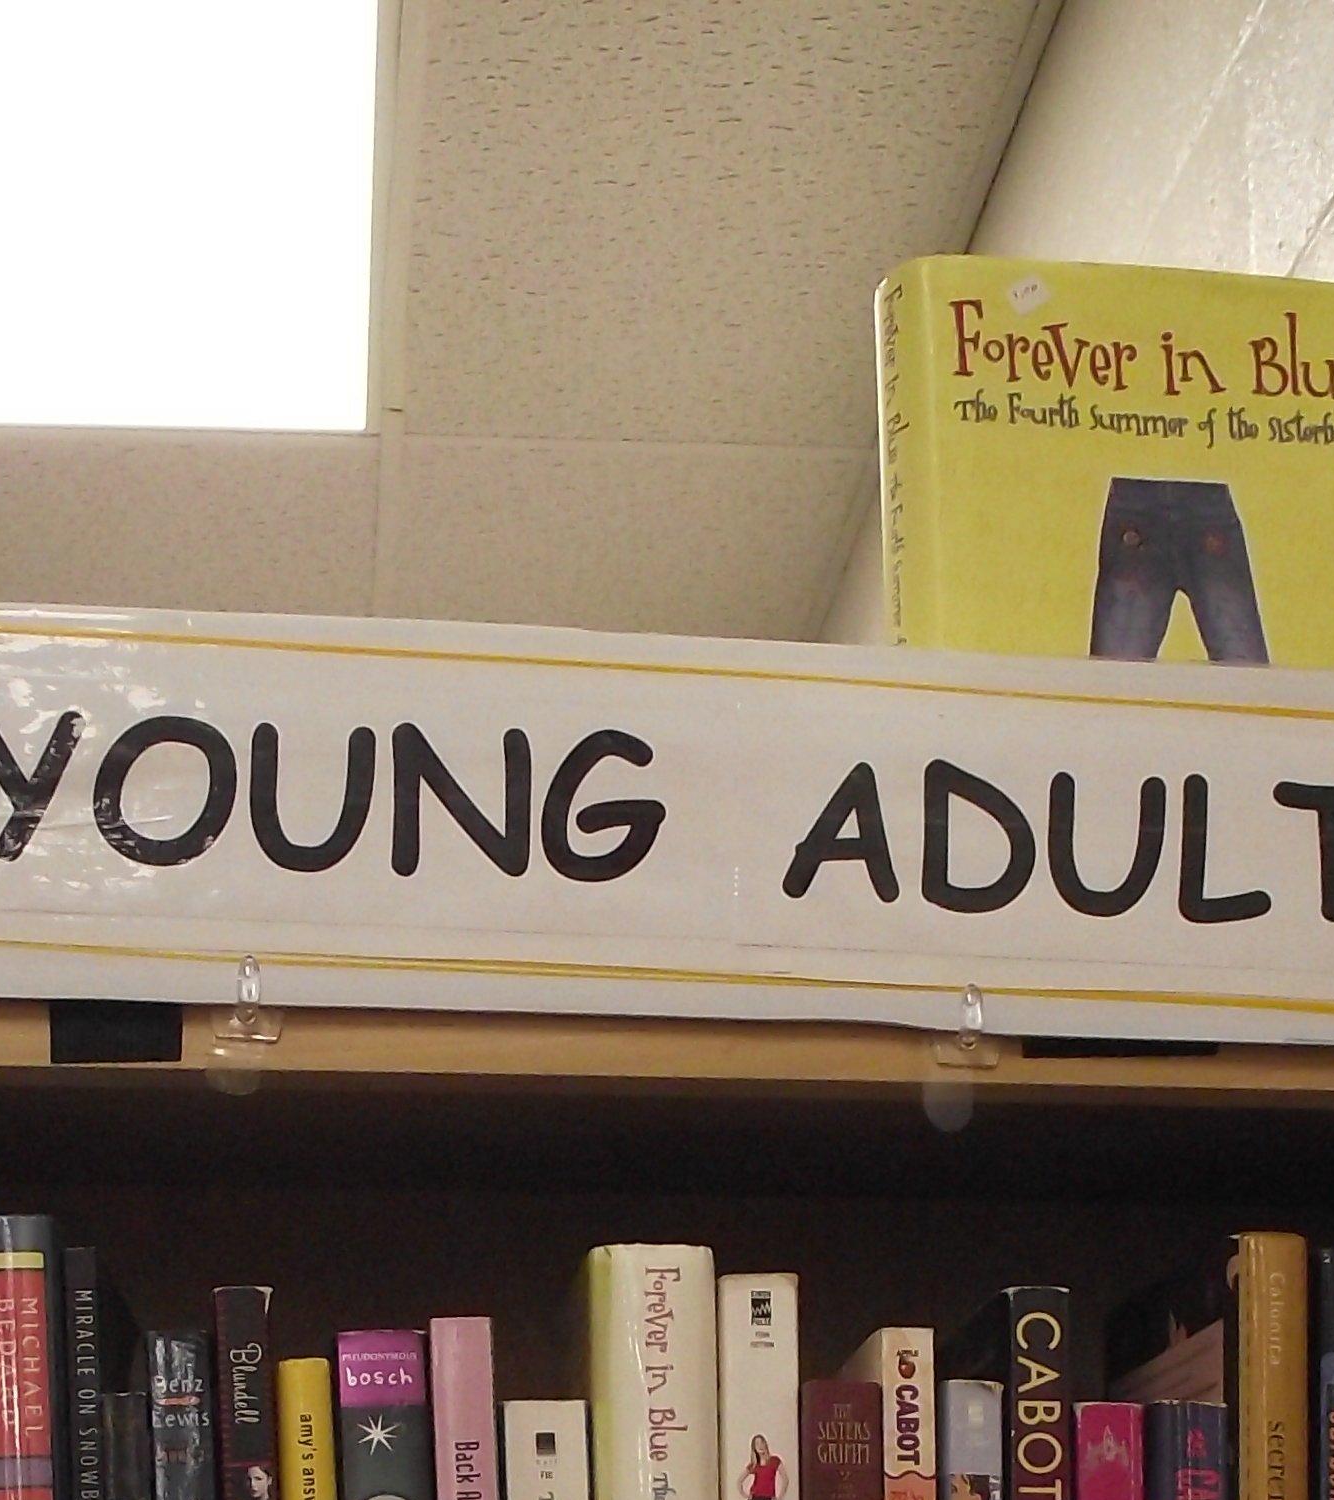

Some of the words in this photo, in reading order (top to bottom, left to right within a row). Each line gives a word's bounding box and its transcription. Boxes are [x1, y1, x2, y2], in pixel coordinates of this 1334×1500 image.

[950, 299, 1138, 390] Forever
[1161, 332, 1226, 395] in
[954, 389, 997, 423] The
[1008, 393, 1079, 429] Fourth
[1090, 405, 1188, 438] Summer
[1198, 407, 1217, 448] of
[1227, 407, 1259, 440] the
[344, 1367, 414, 1386] bosch
[895, 1384, 920, 1467] CABOT
[454, 1441, 481, 1484] Back
